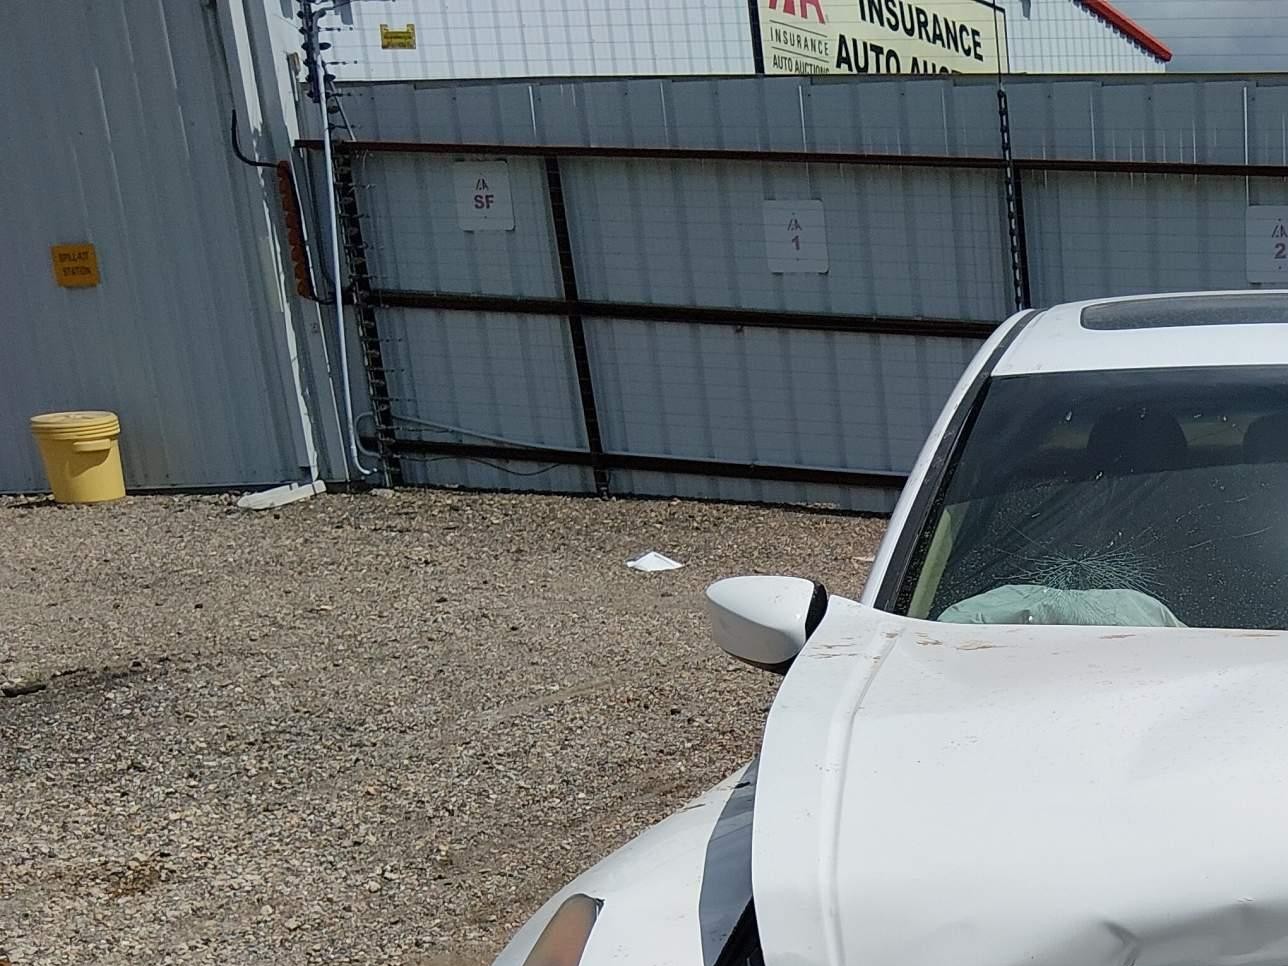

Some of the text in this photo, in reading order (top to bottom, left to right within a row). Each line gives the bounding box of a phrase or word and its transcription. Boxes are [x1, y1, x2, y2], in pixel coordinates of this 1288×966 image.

[859, 0, 984, 61] INSURANCE
[770, 26, 829, 56] INSURANCE
[836, 33, 900, 74] AUTO
[772, 54, 793, 73] AUTO
[474, 194, 494, 209] SF
[791, 235, 800, 251] 1
[1274, 243, 1287, 259] 2
